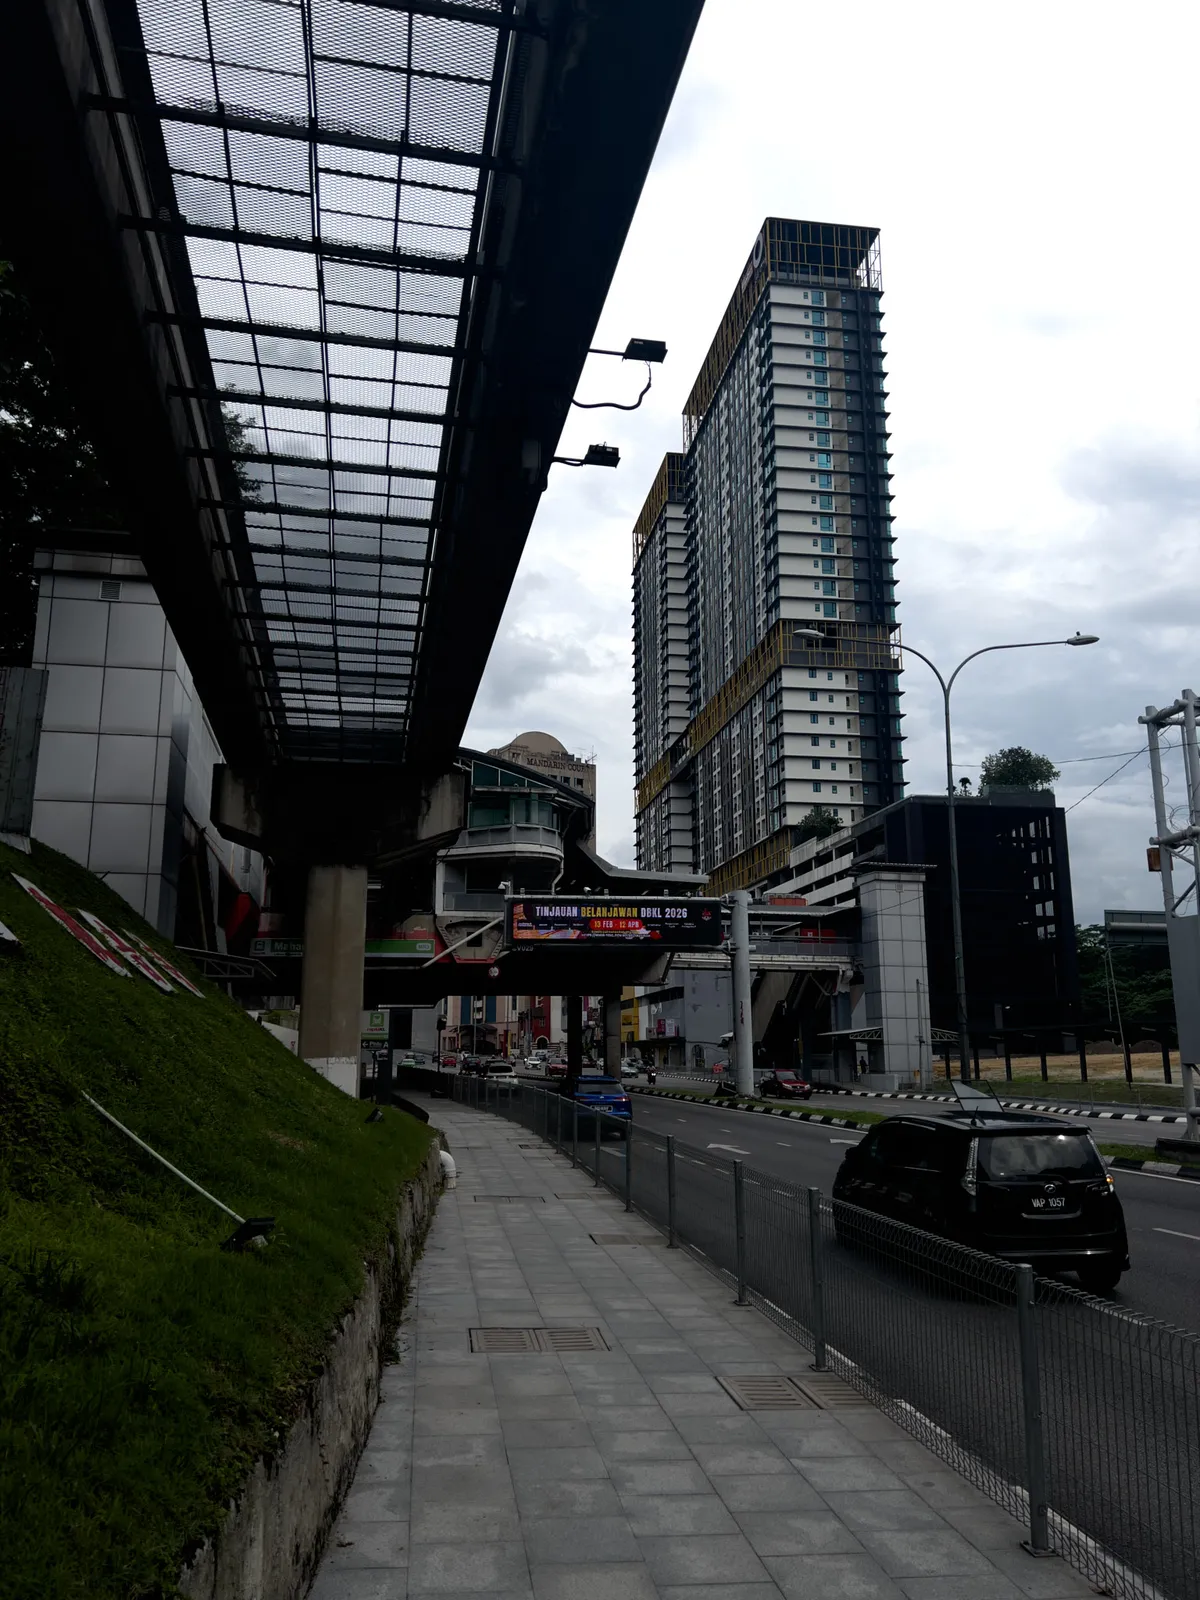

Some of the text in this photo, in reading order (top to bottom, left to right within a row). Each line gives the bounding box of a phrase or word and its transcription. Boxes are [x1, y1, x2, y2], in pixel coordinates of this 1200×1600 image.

[526, 757, 566, 769] MANDARIN
[536, 906, 688, 919] TINJAUAN BELANJAWAN DBKL 2026
[594, 920, 601, 928] 13
[602, 920, 613, 929] FEB
[619, 921, 626, 929] 12
[1031, 1197, 1066, 1208] VAP 1057
